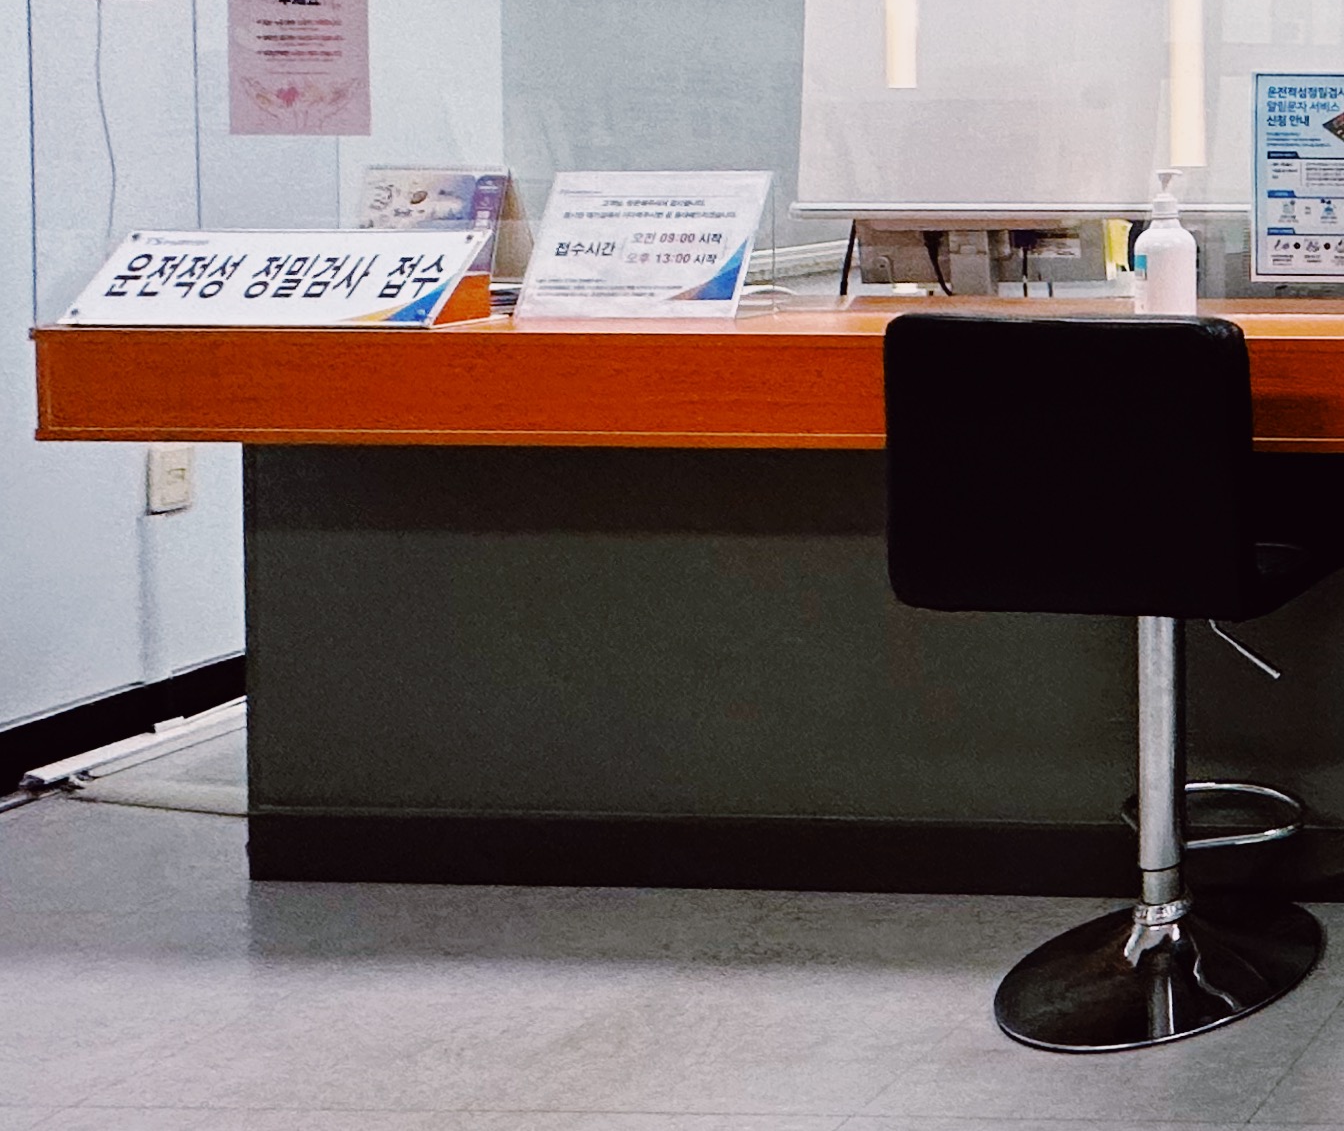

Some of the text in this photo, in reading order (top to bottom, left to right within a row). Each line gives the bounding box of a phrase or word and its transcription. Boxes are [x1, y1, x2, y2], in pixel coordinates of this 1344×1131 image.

[1288, 114, 1310, 127] 안내
[554, 241, 617, 257] 접수시간
[654, 253, 692, 265] 13:00
[104, 253, 445, 299] 운전적성 정밀검사 접수
